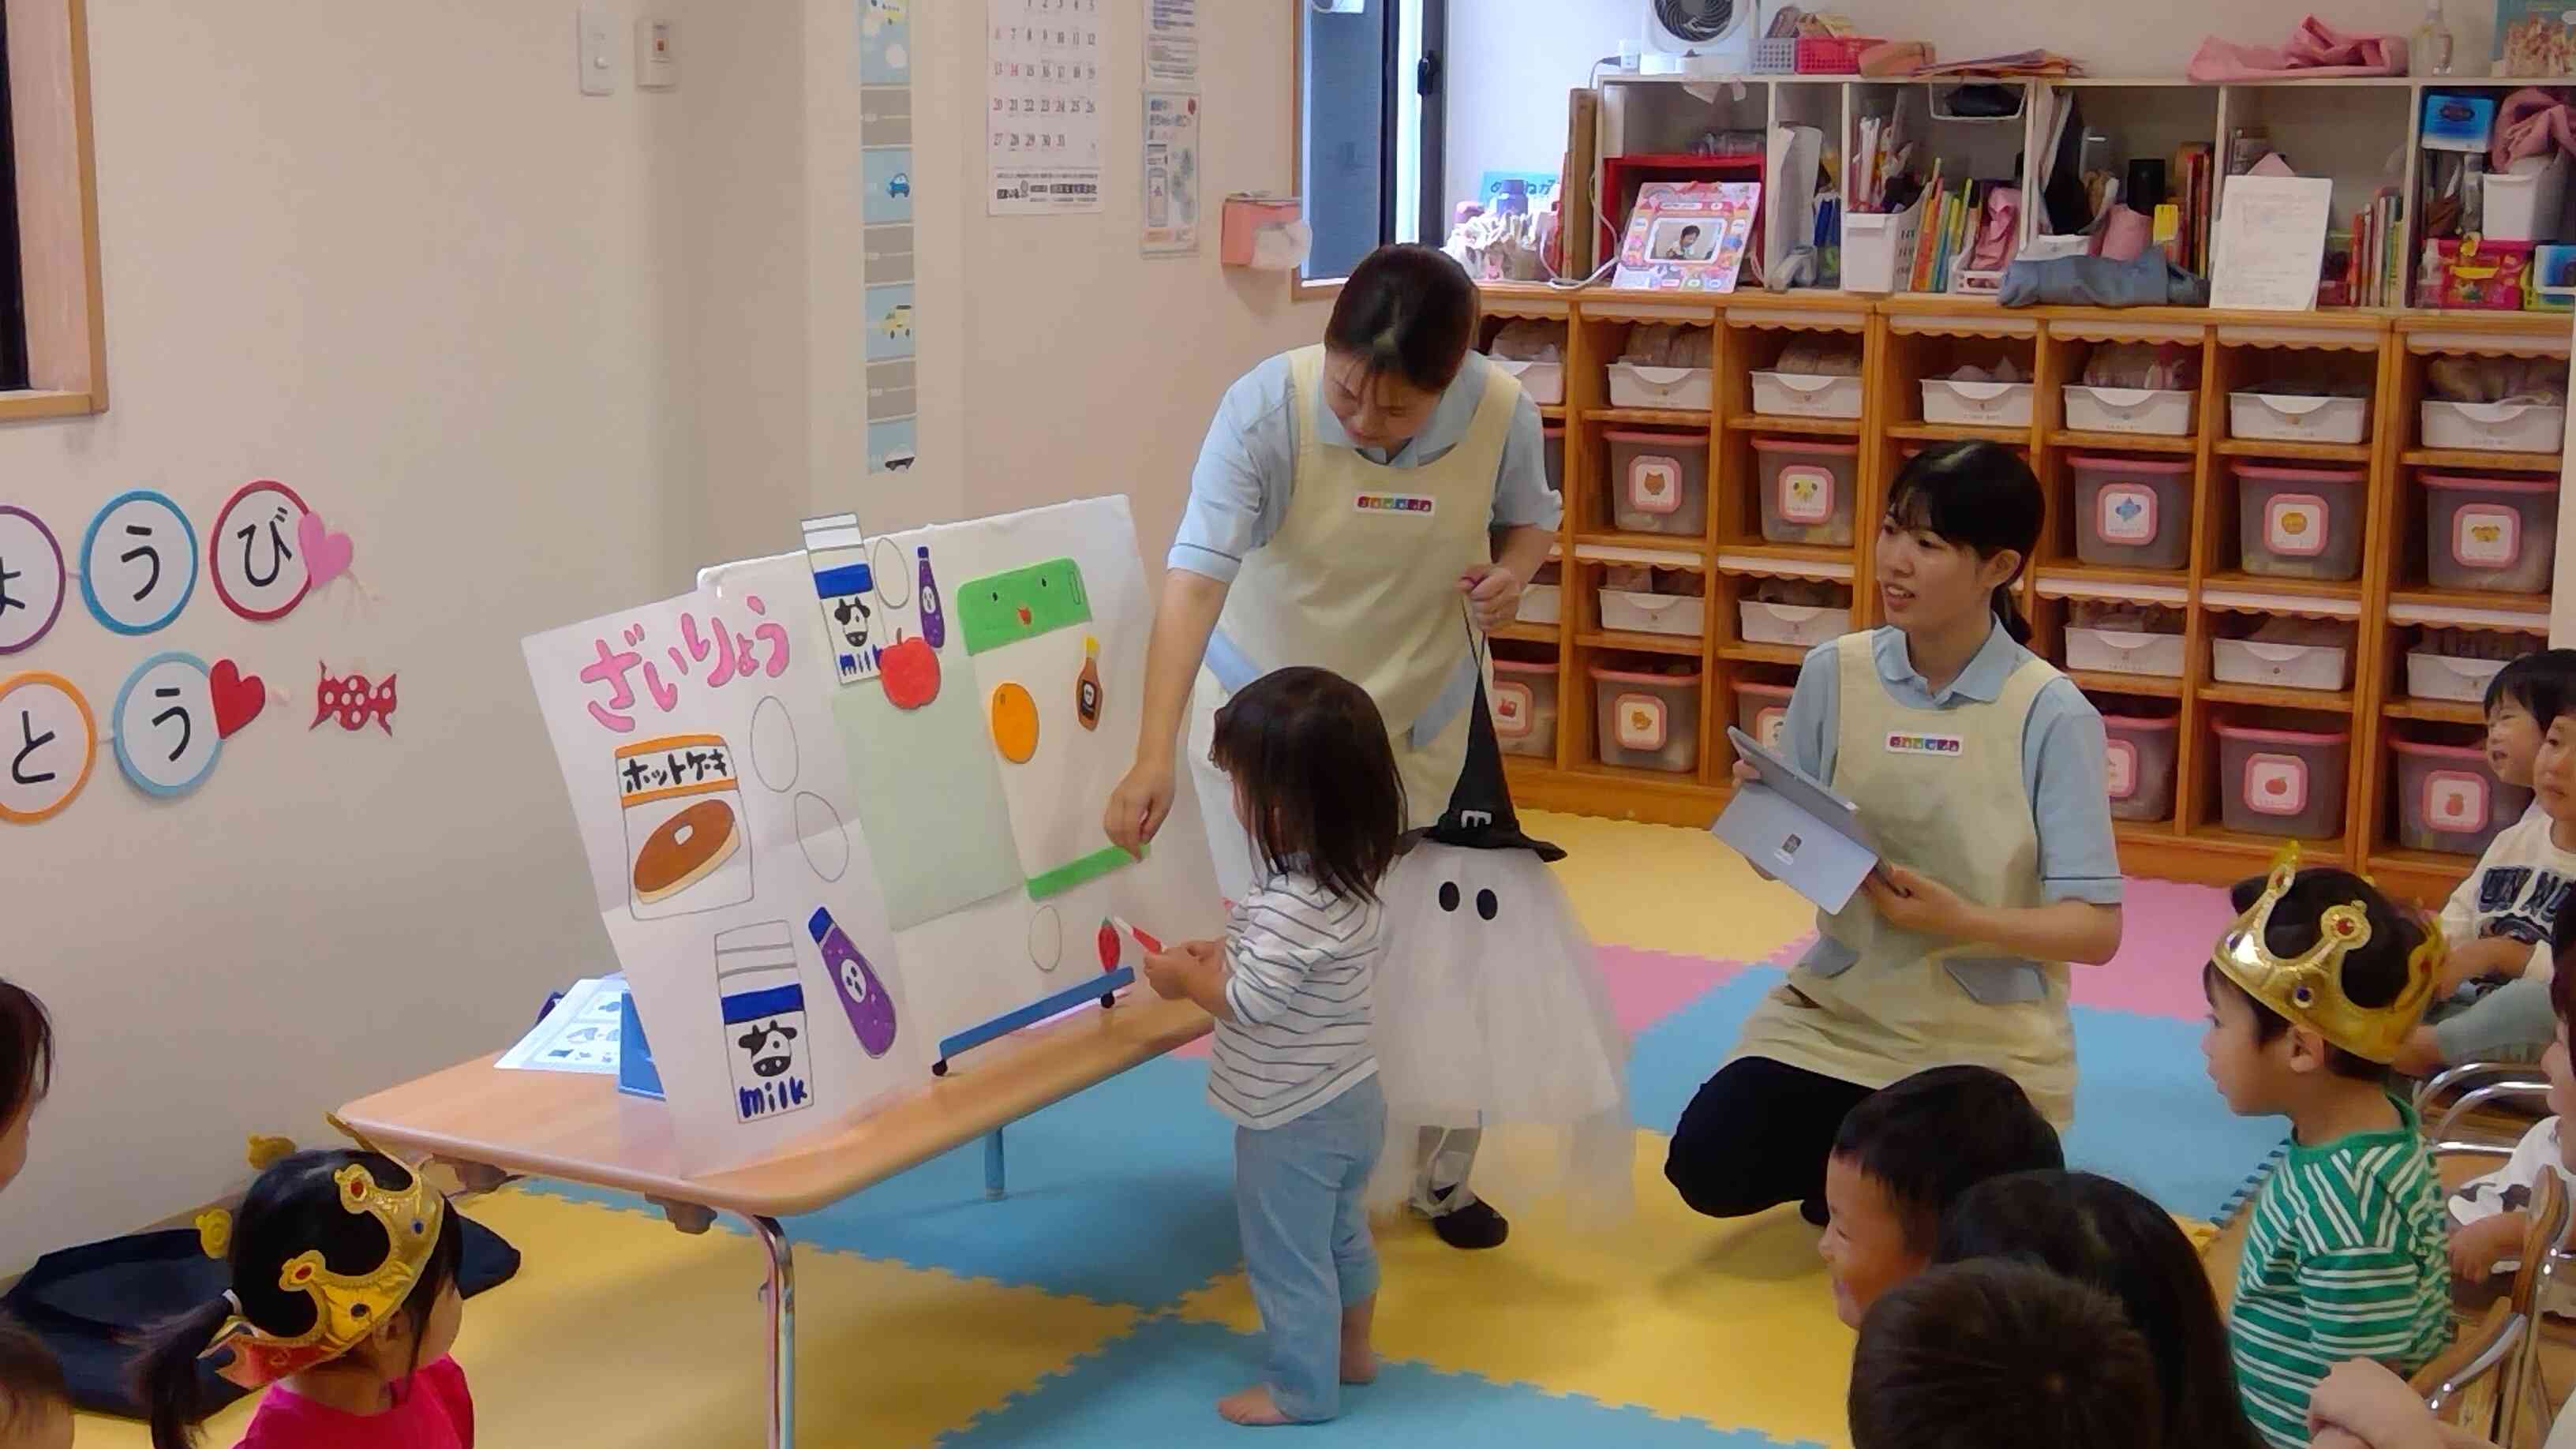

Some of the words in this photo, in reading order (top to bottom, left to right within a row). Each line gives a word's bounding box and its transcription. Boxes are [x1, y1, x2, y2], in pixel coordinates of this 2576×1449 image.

[580, 595, 791, 732] ざいりょう
[11, 687, 192, 784] とう
[739, 1076, 809, 1118] milk
